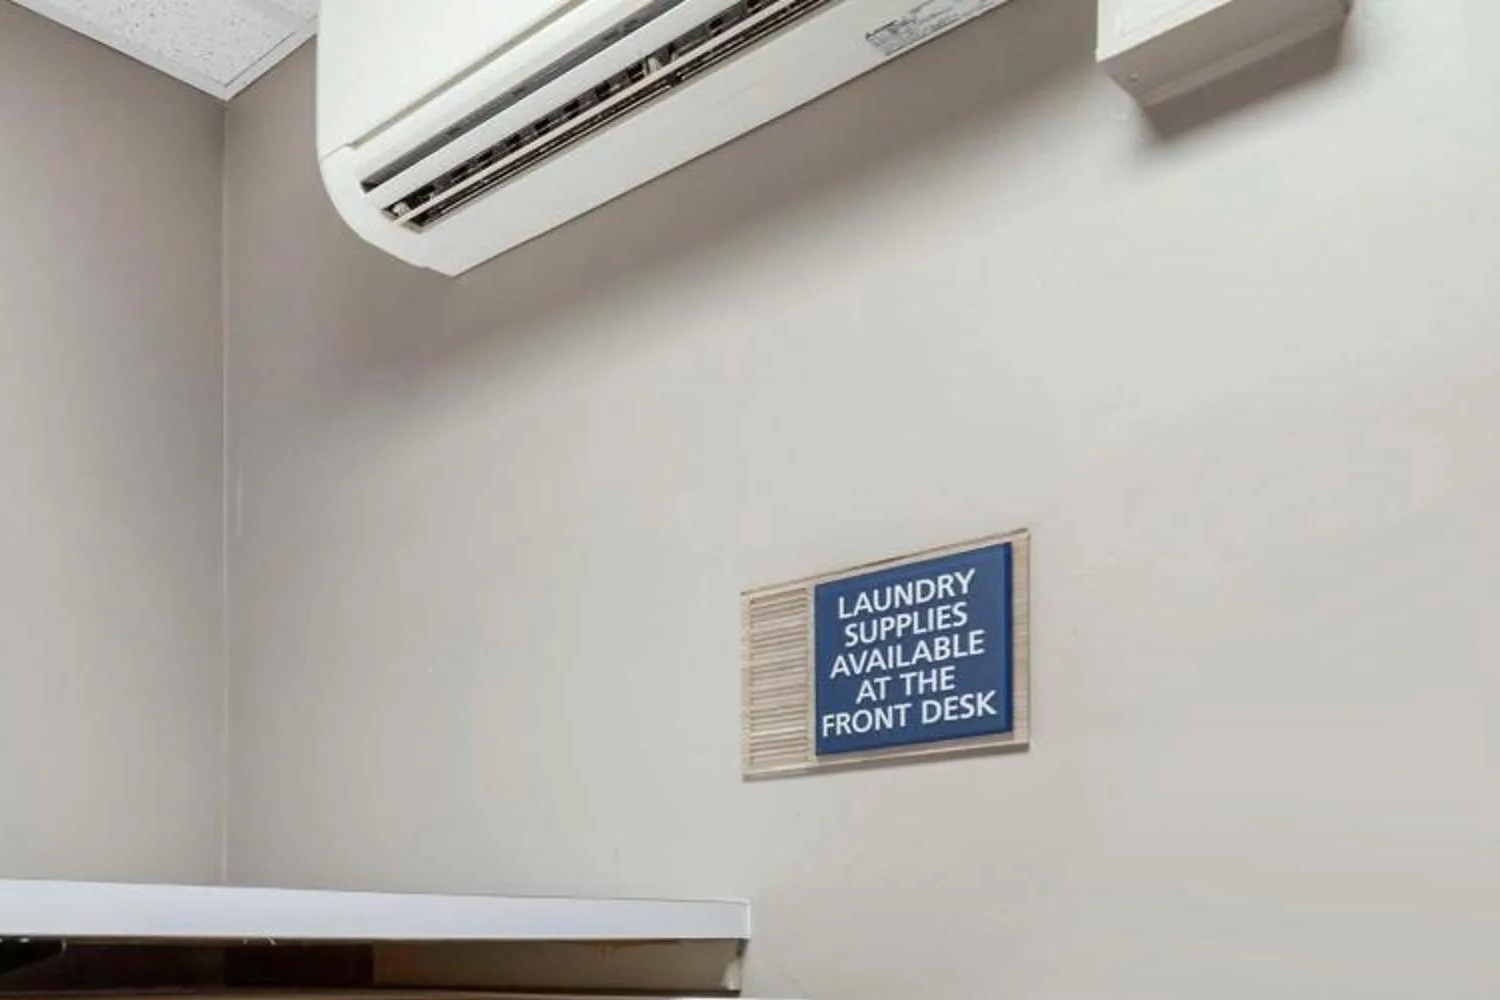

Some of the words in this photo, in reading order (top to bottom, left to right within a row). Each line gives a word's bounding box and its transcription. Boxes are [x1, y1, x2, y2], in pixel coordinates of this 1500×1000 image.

[838, 568, 976, 619] LAUNDRY
[844, 602, 968, 647] SUPPLIES
[830, 629, 985, 679] AVAILABLE
[856, 676, 891, 704] AT
[900, 666, 956, 696] THE
[822, 703, 912, 737] FRONT
[921, 690, 996, 724] DESK
